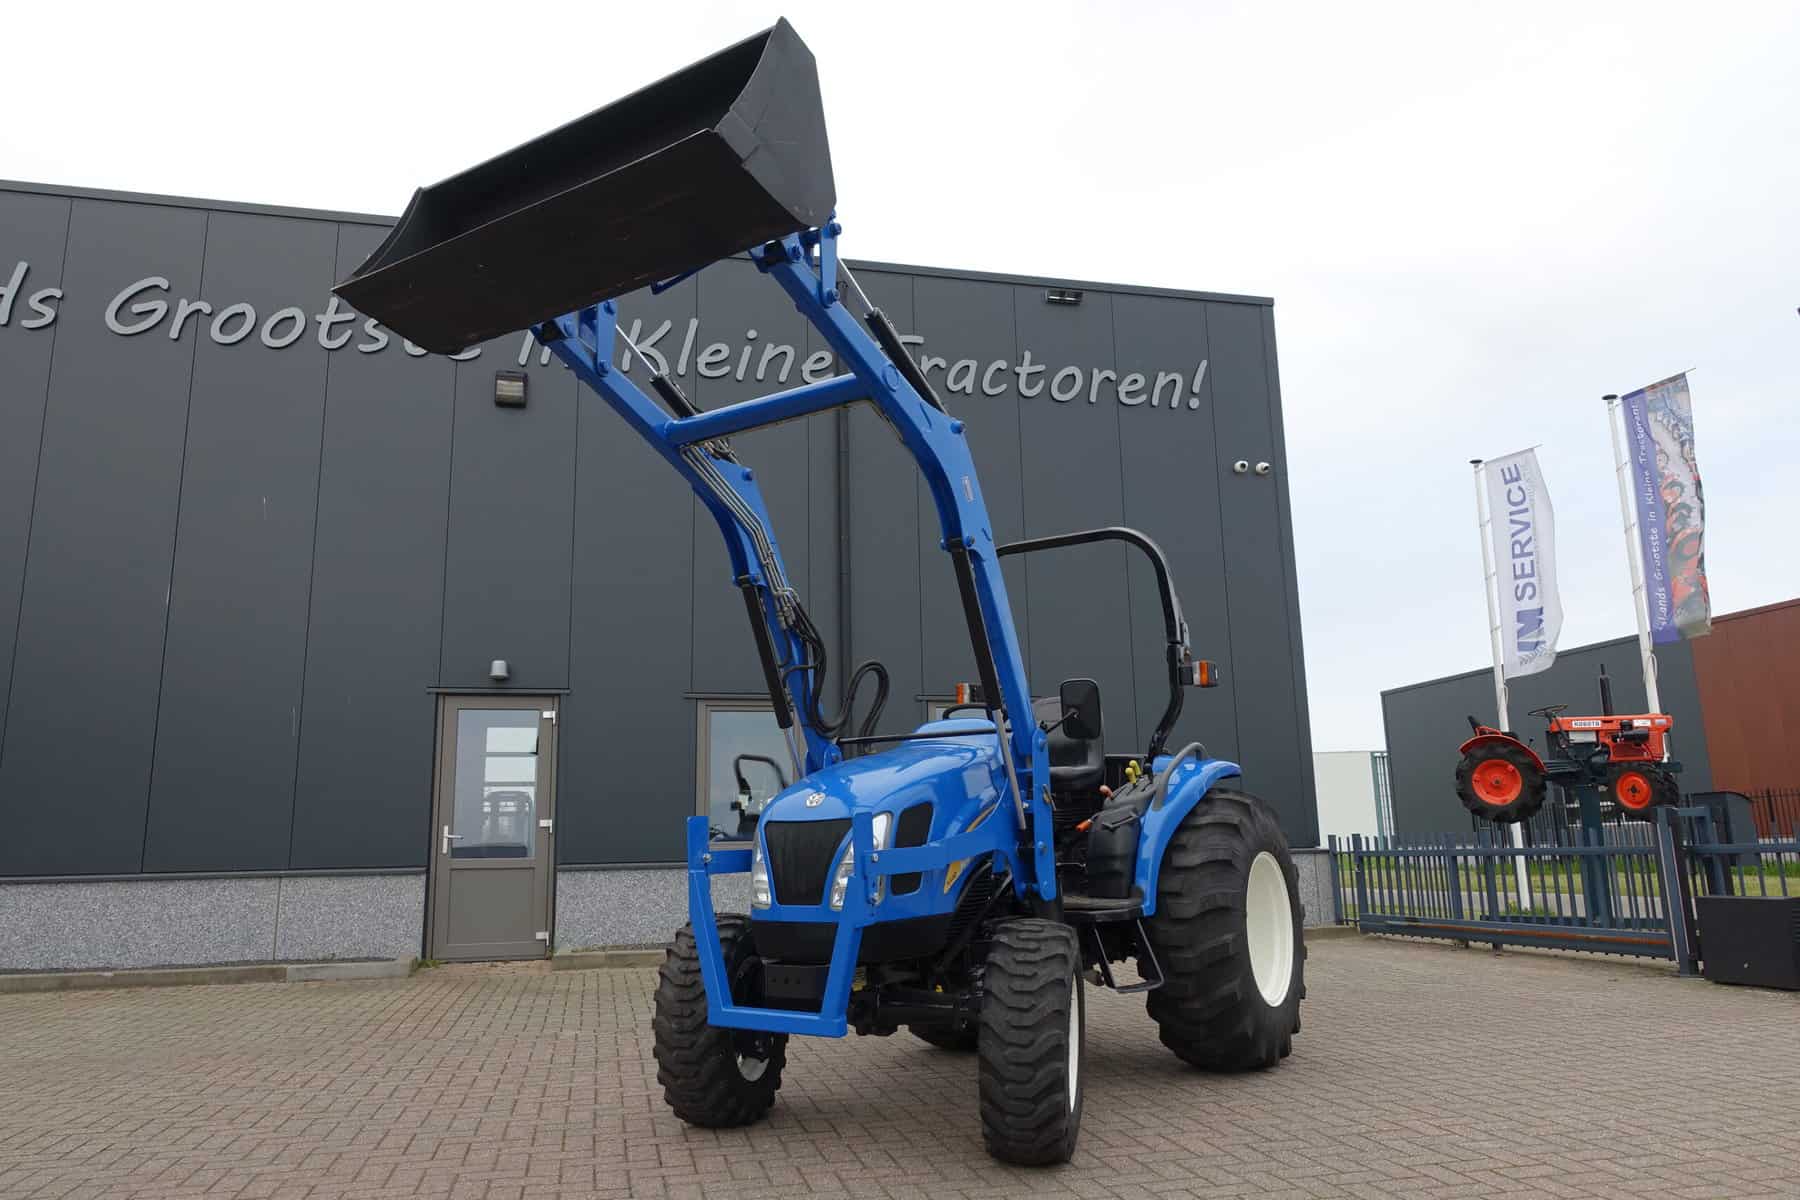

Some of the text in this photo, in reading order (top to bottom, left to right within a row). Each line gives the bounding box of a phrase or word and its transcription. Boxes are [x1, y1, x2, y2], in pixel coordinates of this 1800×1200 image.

[105, 276, 481, 360] Groots
[621, 318, 835, 385] Kleine
[1501, 463, 1537, 602] SERVICE
